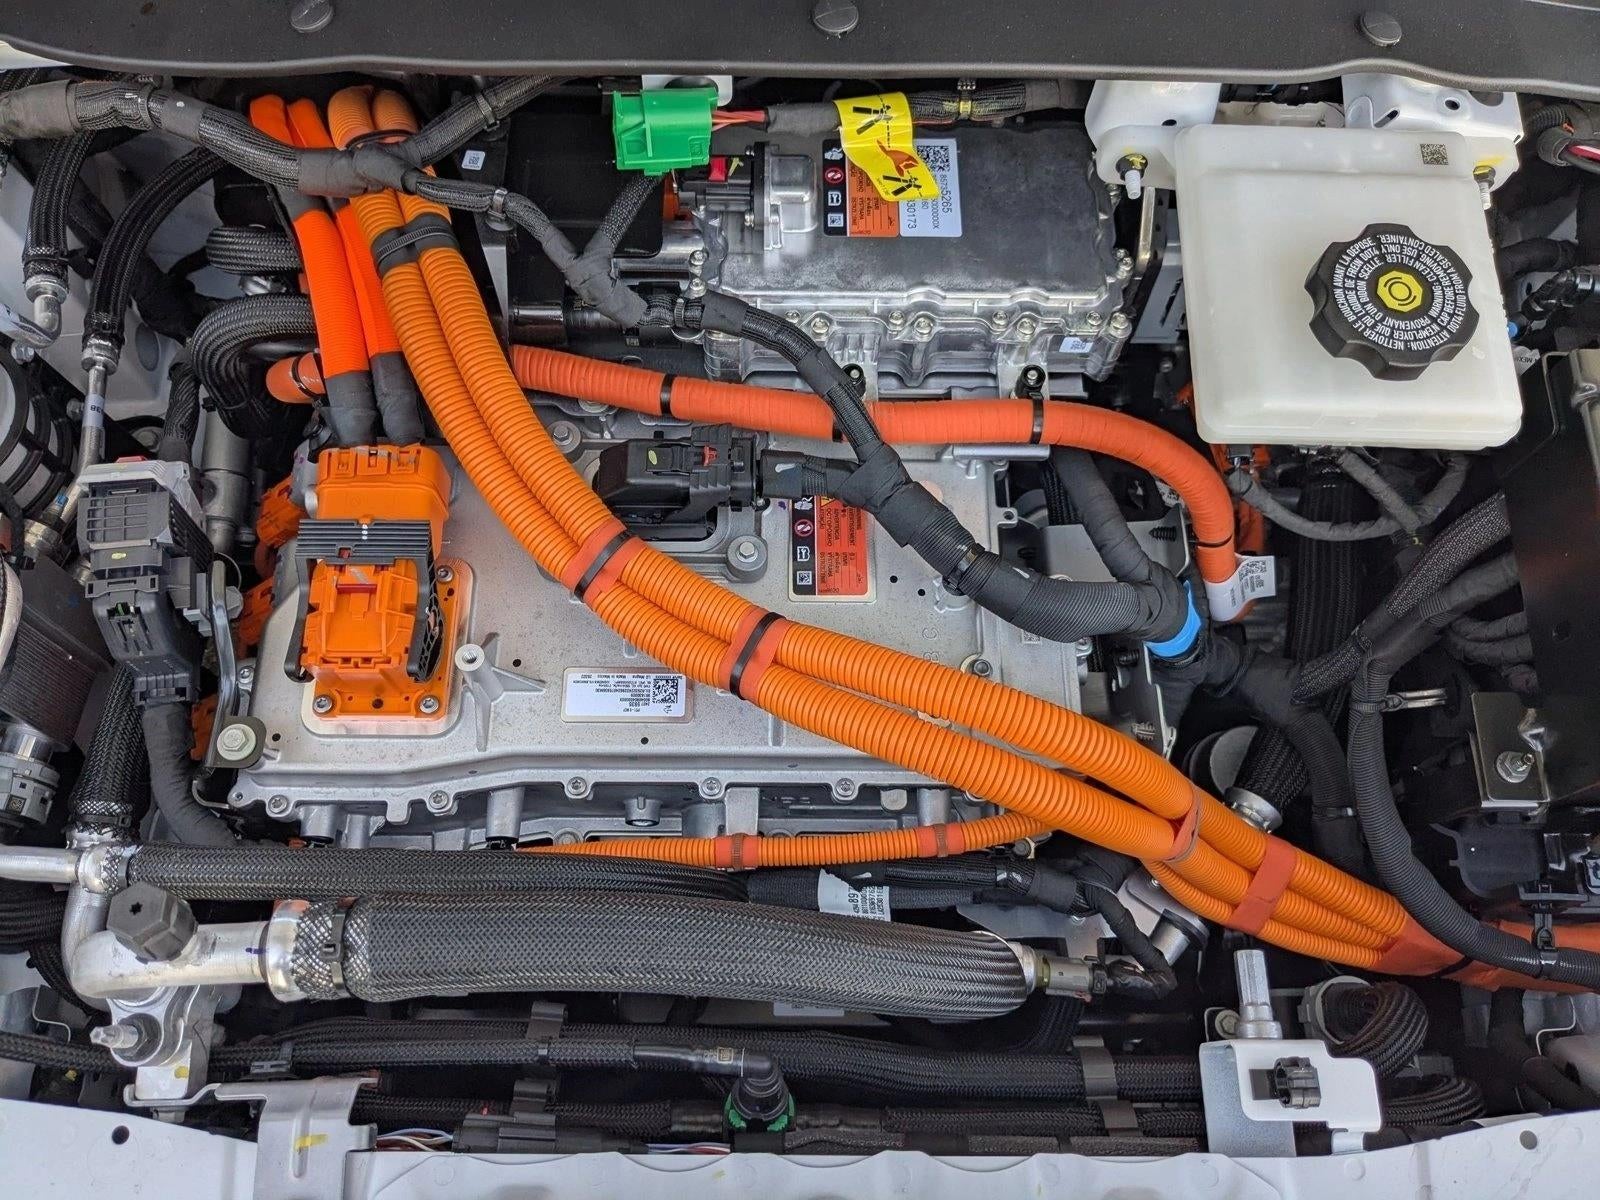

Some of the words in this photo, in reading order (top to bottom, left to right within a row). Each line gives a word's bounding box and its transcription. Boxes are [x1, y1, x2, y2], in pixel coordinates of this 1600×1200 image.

[1376, 234, 1424, 250] CONTAINER.
[1381, 244, 1400, 254] ONLY
[1338, 254, 1352, 266] LA
[1360, 247, 1380, 261] DOT4
[1386, 254, 1414, 266] FILLER
[1402, 246, 1418, 258] USE
[1424, 245, 1452, 268] SEALED
[1333, 264, 1346, 288] AVANT
[1346, 258, 1364, 278] FREIN
[1414, 262, 1436, 282] CLEAN
[1420, 251, 1452, 286] REMOVING.
[1344, 278, 1354, 288] DE
[1356, 280, 1370, 302] BIDON
[1450, 272, 1466, 294] FROM
[1333, 288, 1356, 322] BOUCHON
[1346, 290, 1366, 316] LIQUIDE
[1428, 282, 1444, 318] WARNING:
[1443, 286, 1455, 314] BEFORE
[1455, 294, 1466, 316] FLUID
[1364, 302, 1384, 320] D'UN
[1437, 312, 1450, 326] CAP
[1352, 320, 1366, 332] LE
[1362, 316, 1374, 326] DU
[1374, 322, 1390, 336] QUE
[1382, 316, 1431, 330] PROVENANT
[1447, 315, 1464, 333] DOT4
[1364, 328, 1404, 350] NETTOYER
[1393, 323, 1440, 340] N'EMPLOYER
